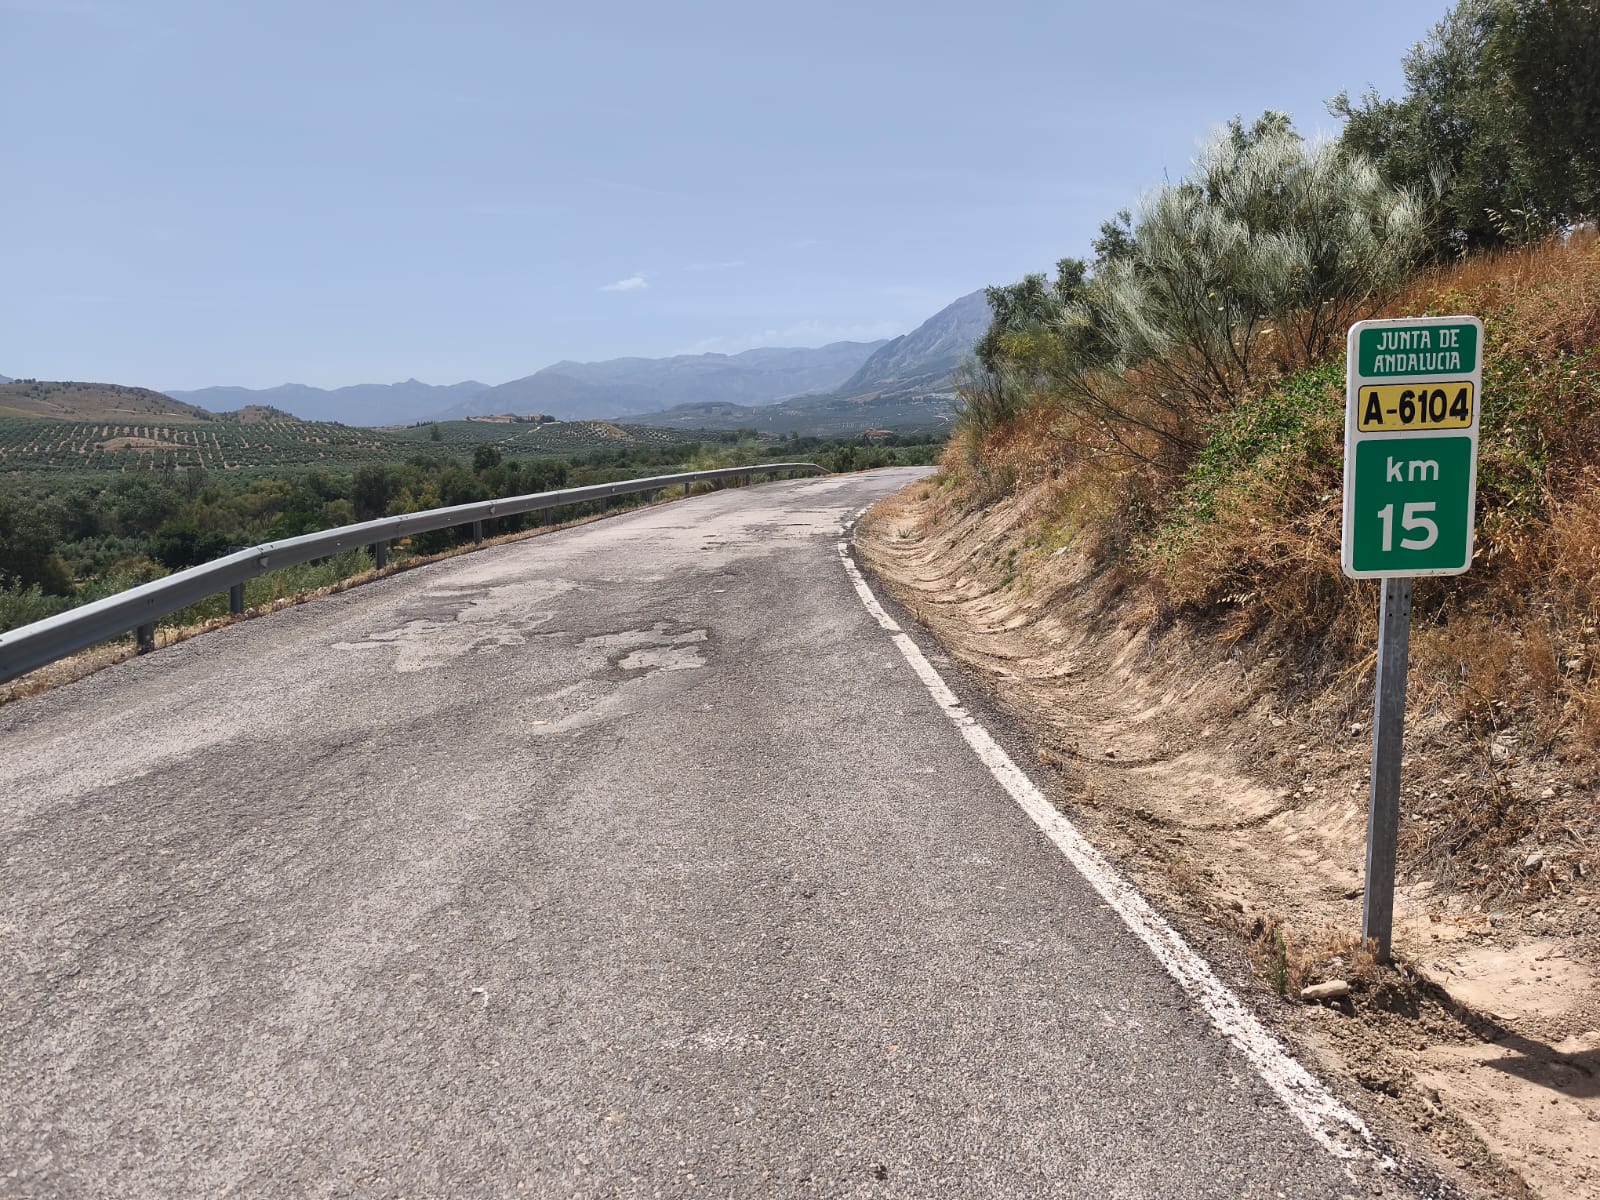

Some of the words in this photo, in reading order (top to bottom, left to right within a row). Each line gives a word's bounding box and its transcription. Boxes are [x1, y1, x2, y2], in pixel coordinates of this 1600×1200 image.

[1377, 330, 1431, 350] JUNTA
[1439, 329, 1460, 347] DE
[1363, 388, 1468, 425] A-6104
[1386, 456, 1440, 482] km
[1377, 501, 1439, 551] 15
